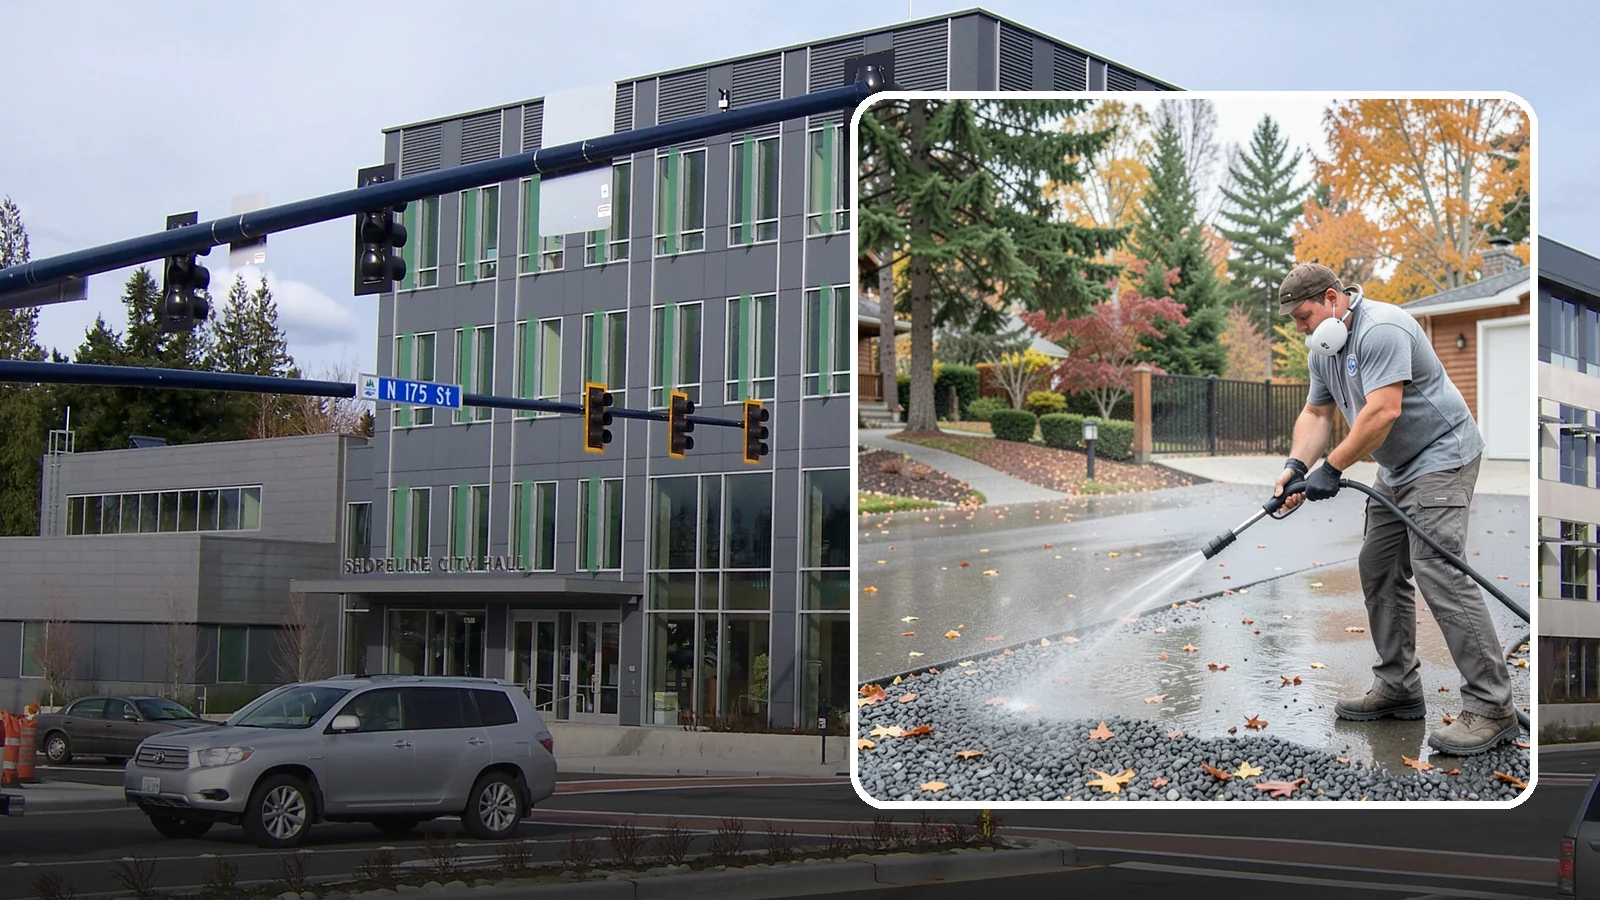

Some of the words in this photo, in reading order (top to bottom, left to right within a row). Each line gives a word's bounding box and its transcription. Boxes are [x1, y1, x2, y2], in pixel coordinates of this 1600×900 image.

[387, 380, 396, 400] N
[405, 382, 428, 403] 175
[436, 386, 451, 406] St
[343, 556, 432, 575] SHORELINE
[438, 555, 476, 574] CITY
[483, 555, 525, 572] HALL
